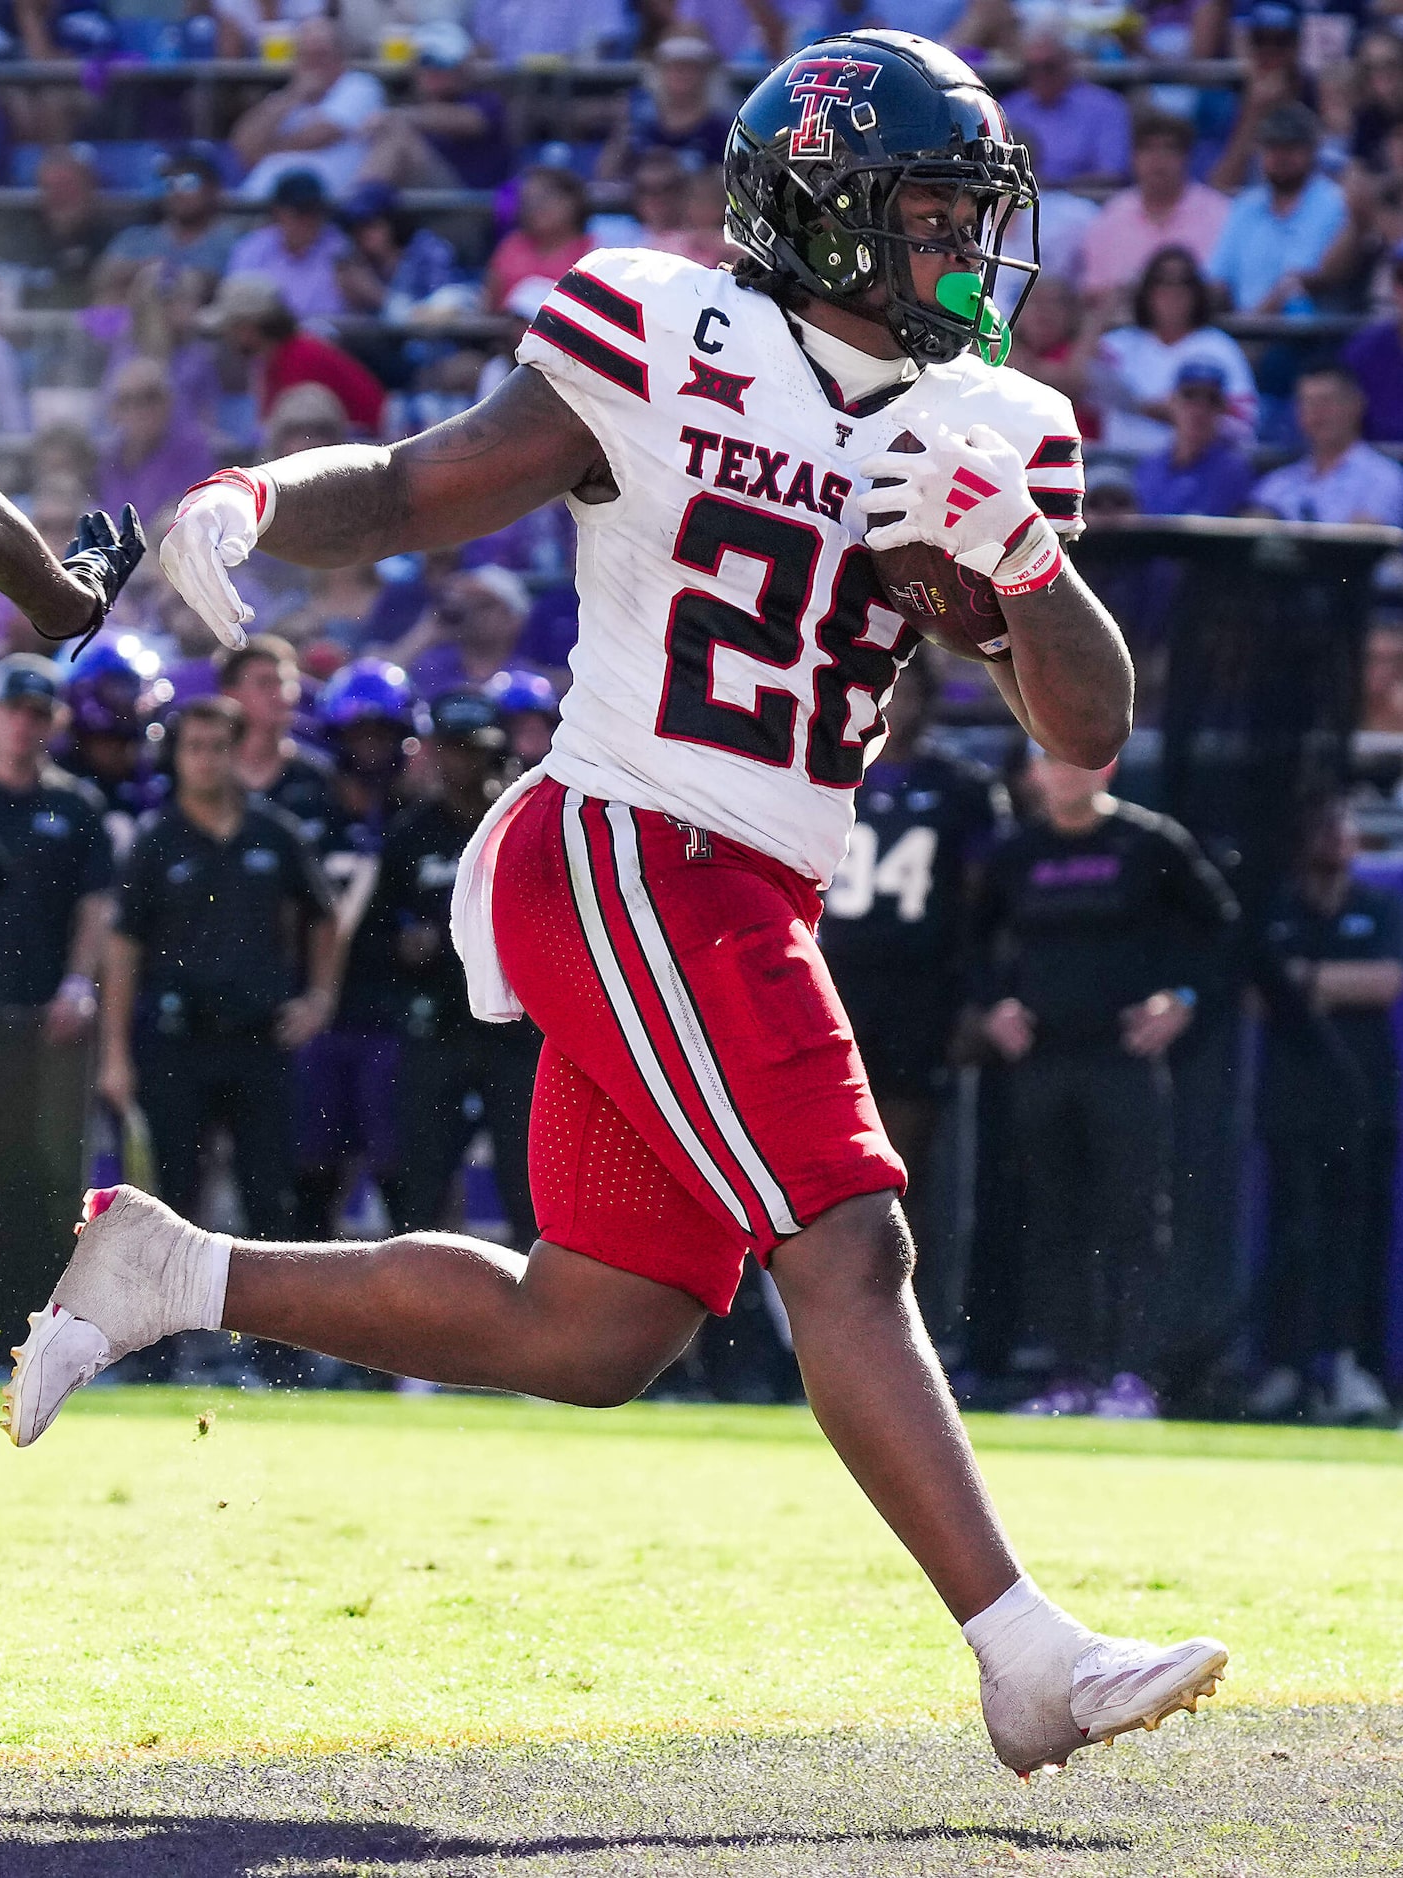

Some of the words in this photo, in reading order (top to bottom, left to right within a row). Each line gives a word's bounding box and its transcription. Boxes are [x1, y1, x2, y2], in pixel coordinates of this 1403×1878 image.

[692, 306, 731, 355] C
[679, 424, 853, 525] TEXAS
[1031, 549, 1052, 572] WRECK
[654, 490, 918, 790] 28
